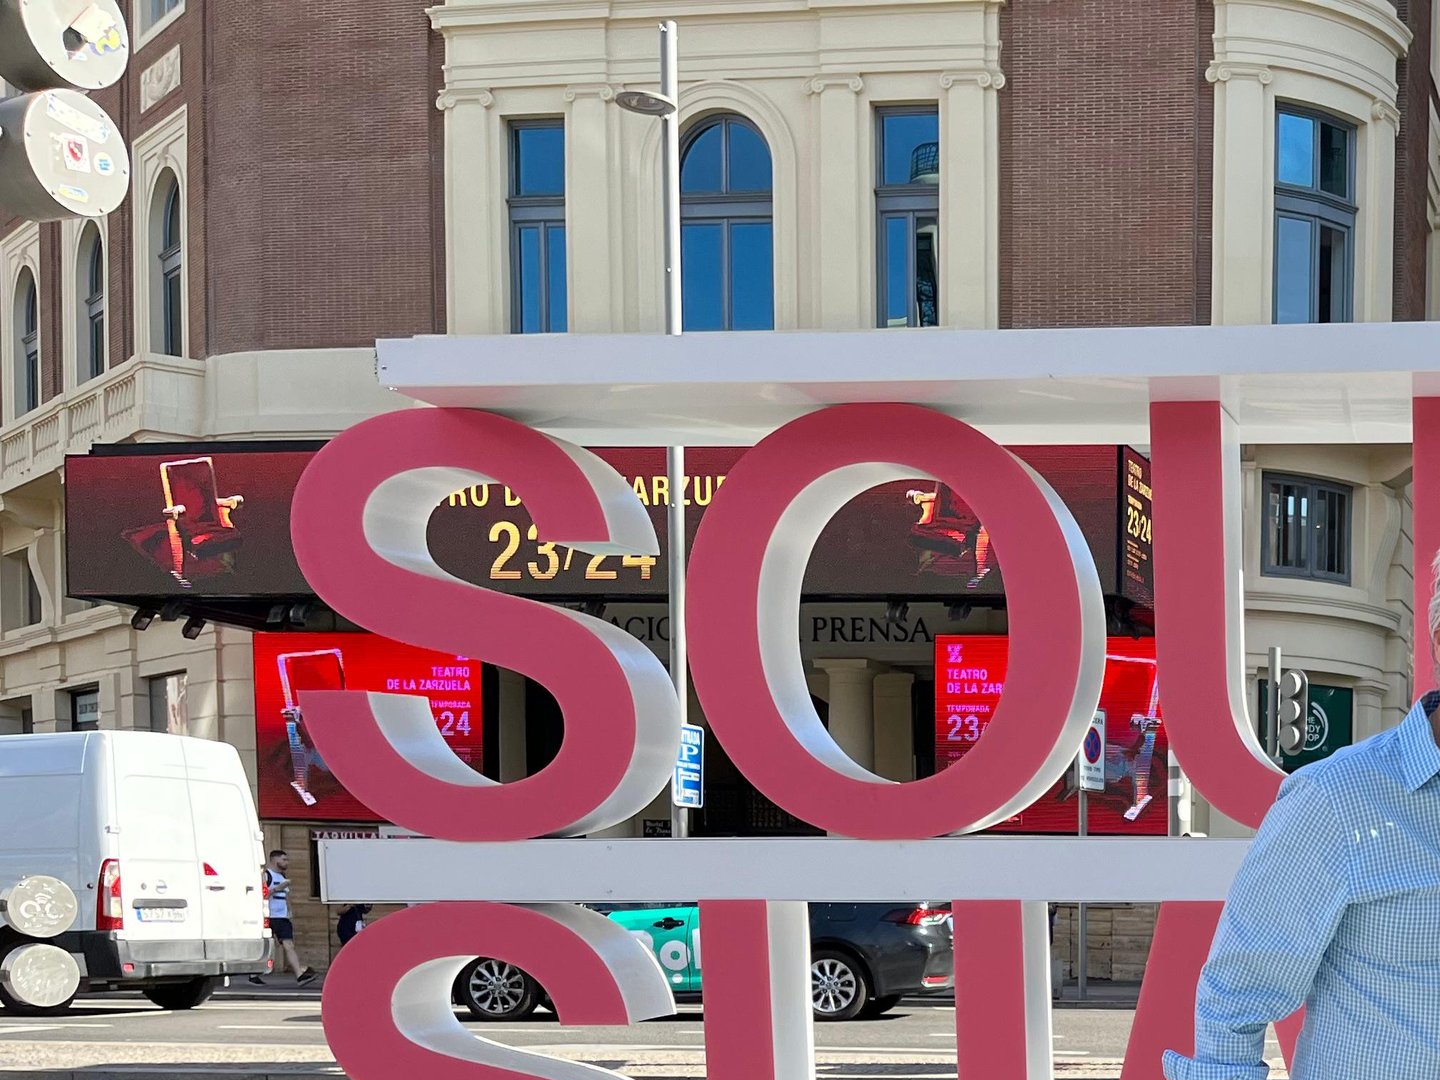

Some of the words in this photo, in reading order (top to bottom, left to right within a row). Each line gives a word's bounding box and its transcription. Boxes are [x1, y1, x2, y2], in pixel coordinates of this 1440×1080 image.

[812, 616, 934, 642] PRENSA
[432, 667, 470, 677] TEATRO
[947, 668, 988, 680] TEATRO
[387, 679, 400, 690] DE
[403, 680, 416, 690] LA
[419, 679, 471, 691] ZARZUELA
[947, 683, 961, 694] DE
[964, 683, 978, 694] LA
[680, 744, 699, 762] P
